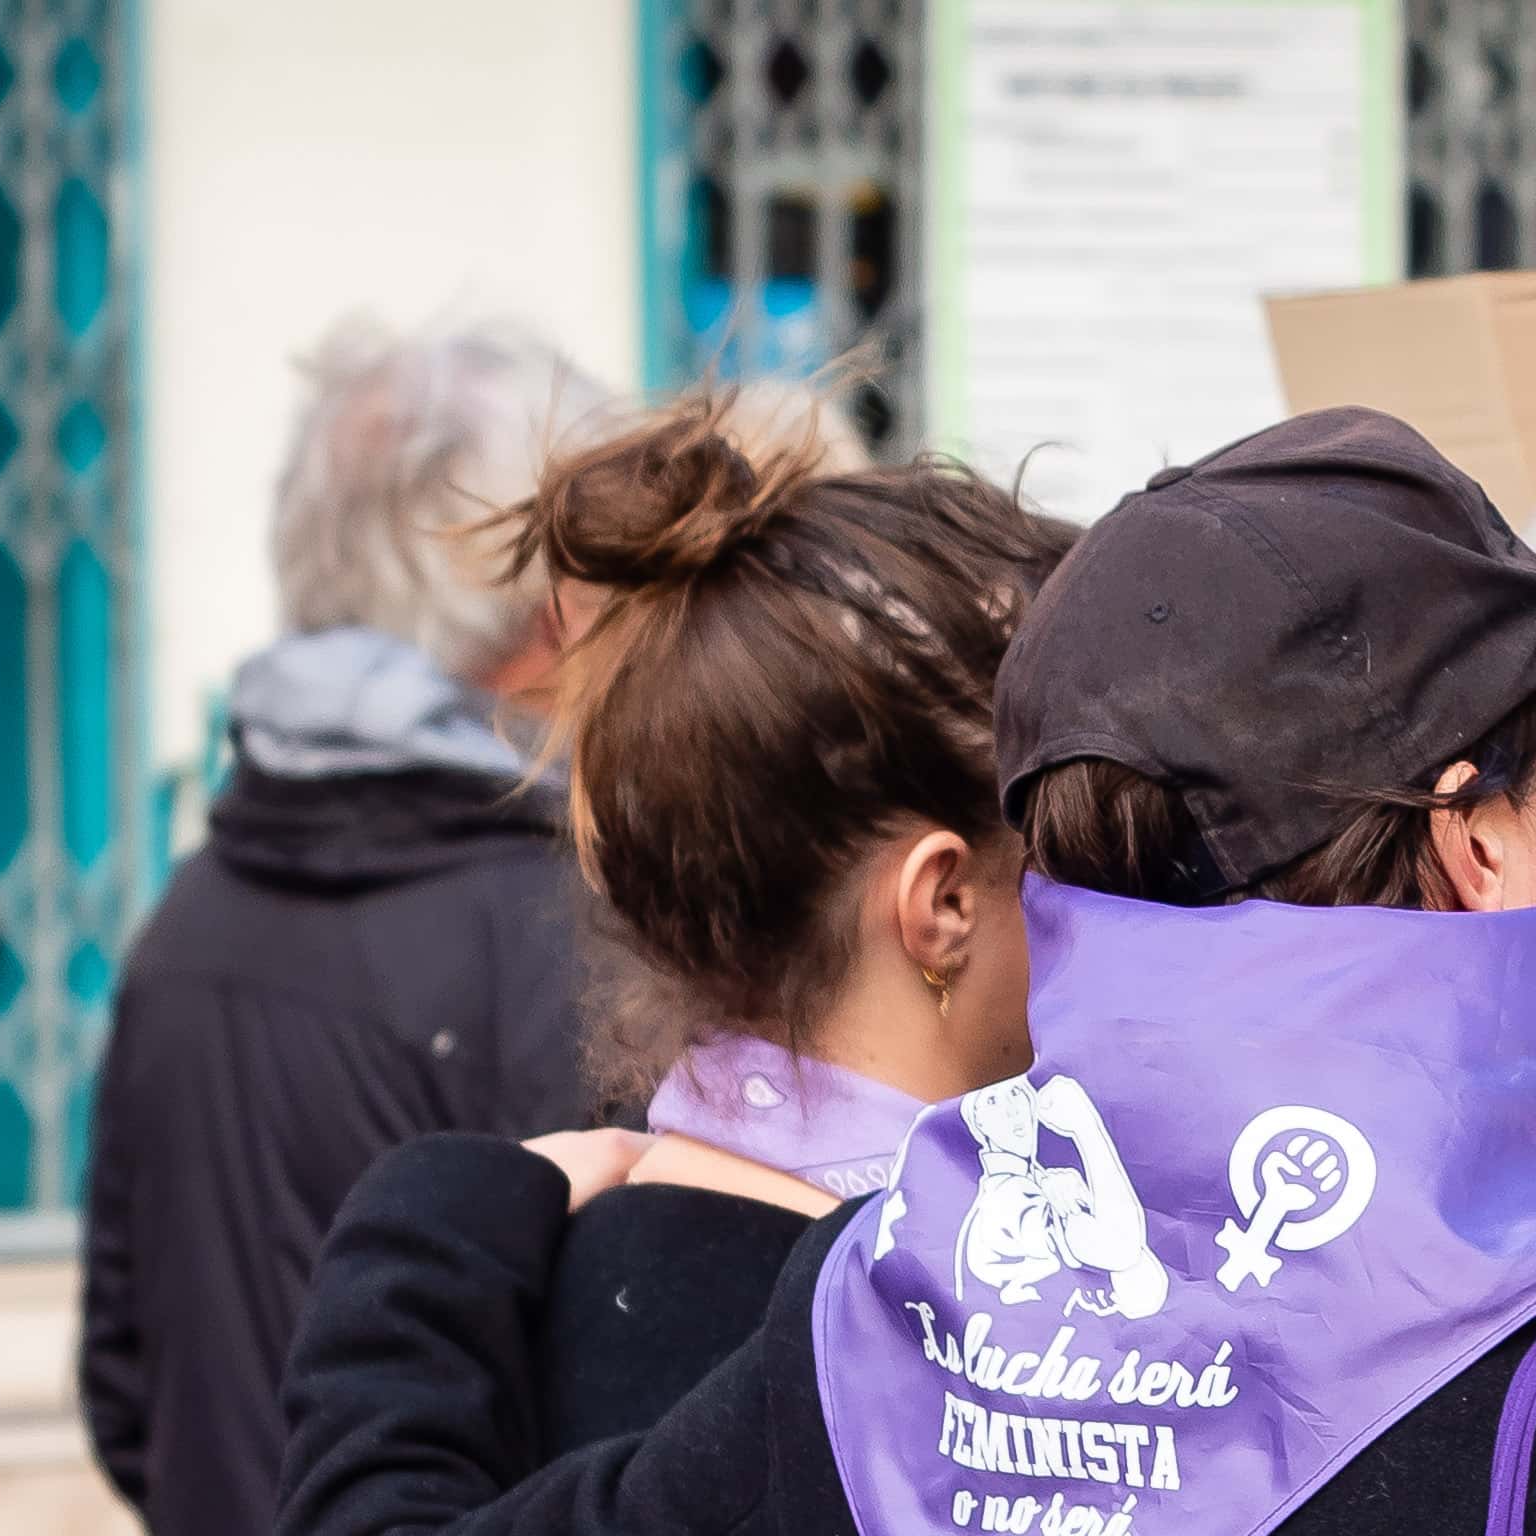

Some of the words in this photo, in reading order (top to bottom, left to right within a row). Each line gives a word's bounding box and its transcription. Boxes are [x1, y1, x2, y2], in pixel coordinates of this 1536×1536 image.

[964, 1312, 1101, 1401] lucha
[1108, 1340, 1239, 1409] será
[938, 1390, 1181, 1491] FEMINISTA
[952, 1490, 978, 1526] o
[981, 1495, 1043, 1535] no
